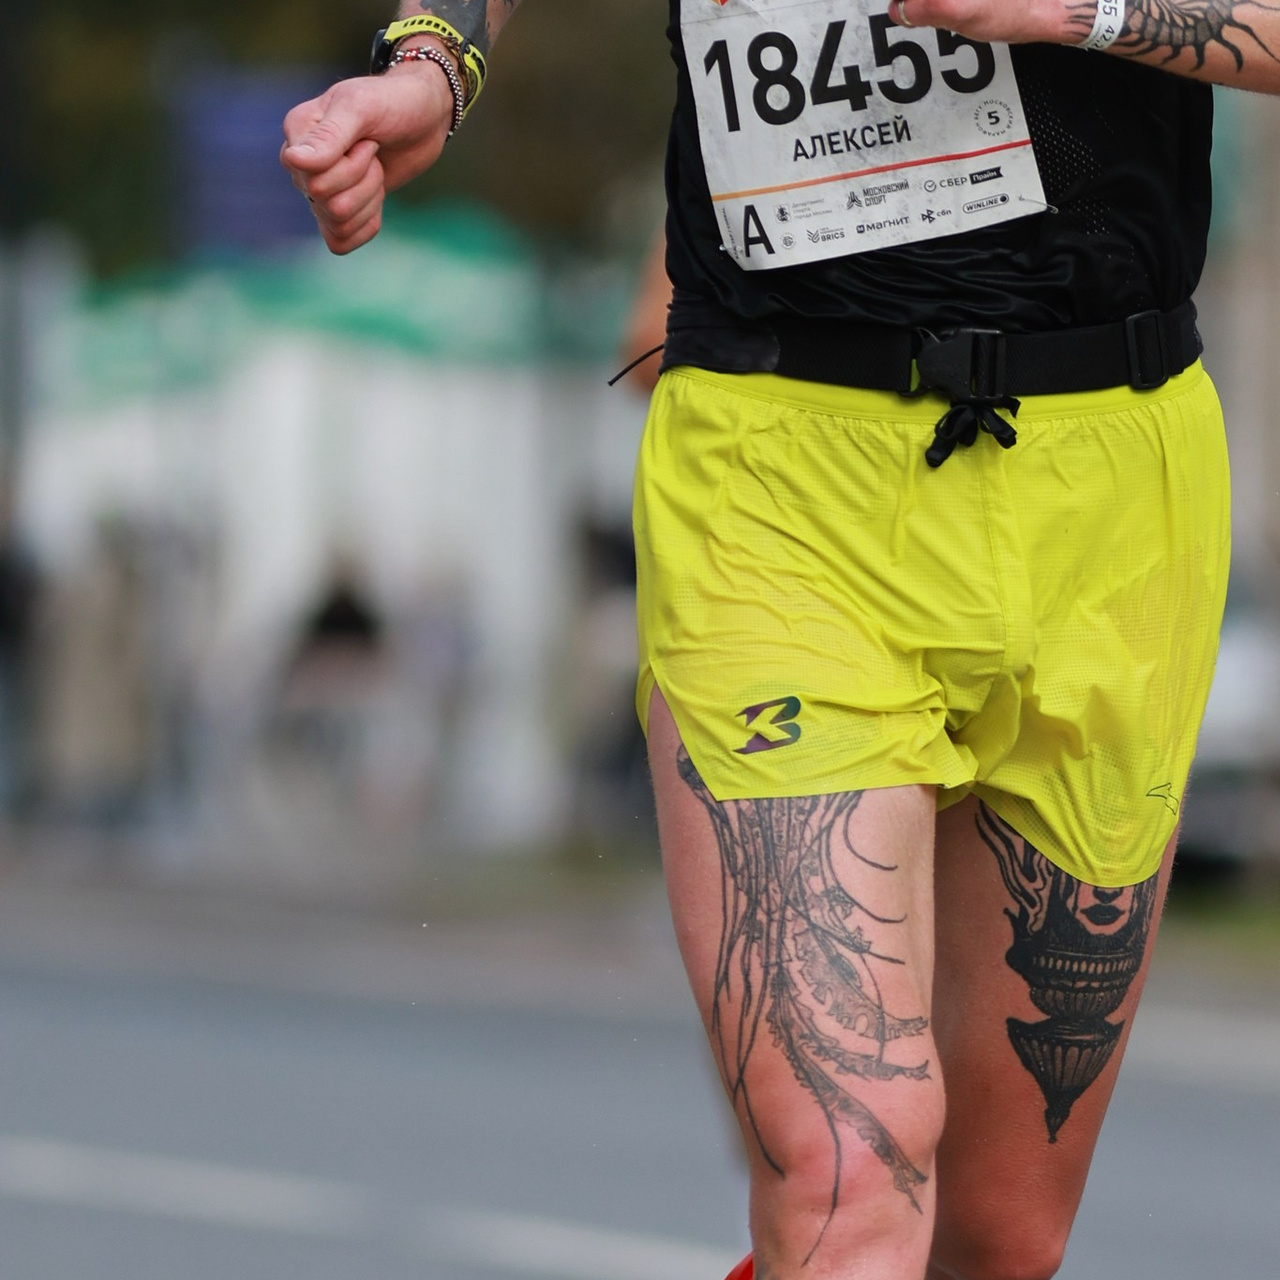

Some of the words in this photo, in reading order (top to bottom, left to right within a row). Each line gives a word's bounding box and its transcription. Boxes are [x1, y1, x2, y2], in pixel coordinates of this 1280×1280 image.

[703, 13, 996, 133] 18455
[987, 110, 1000, 125] 5
[793, 115, 912, 162] АЛЕКСЕЙ
[939, 177, 968, 188] СБЕР
[971, 170, 998, 183] Прайм
[862, 179, 909, 196] МОСКОВСКИЙ
[864, 194, 887, 207] СПОРТ
[966, 198, 999, 212] WINLINE
[821, 231, 845, 242] BRICS
